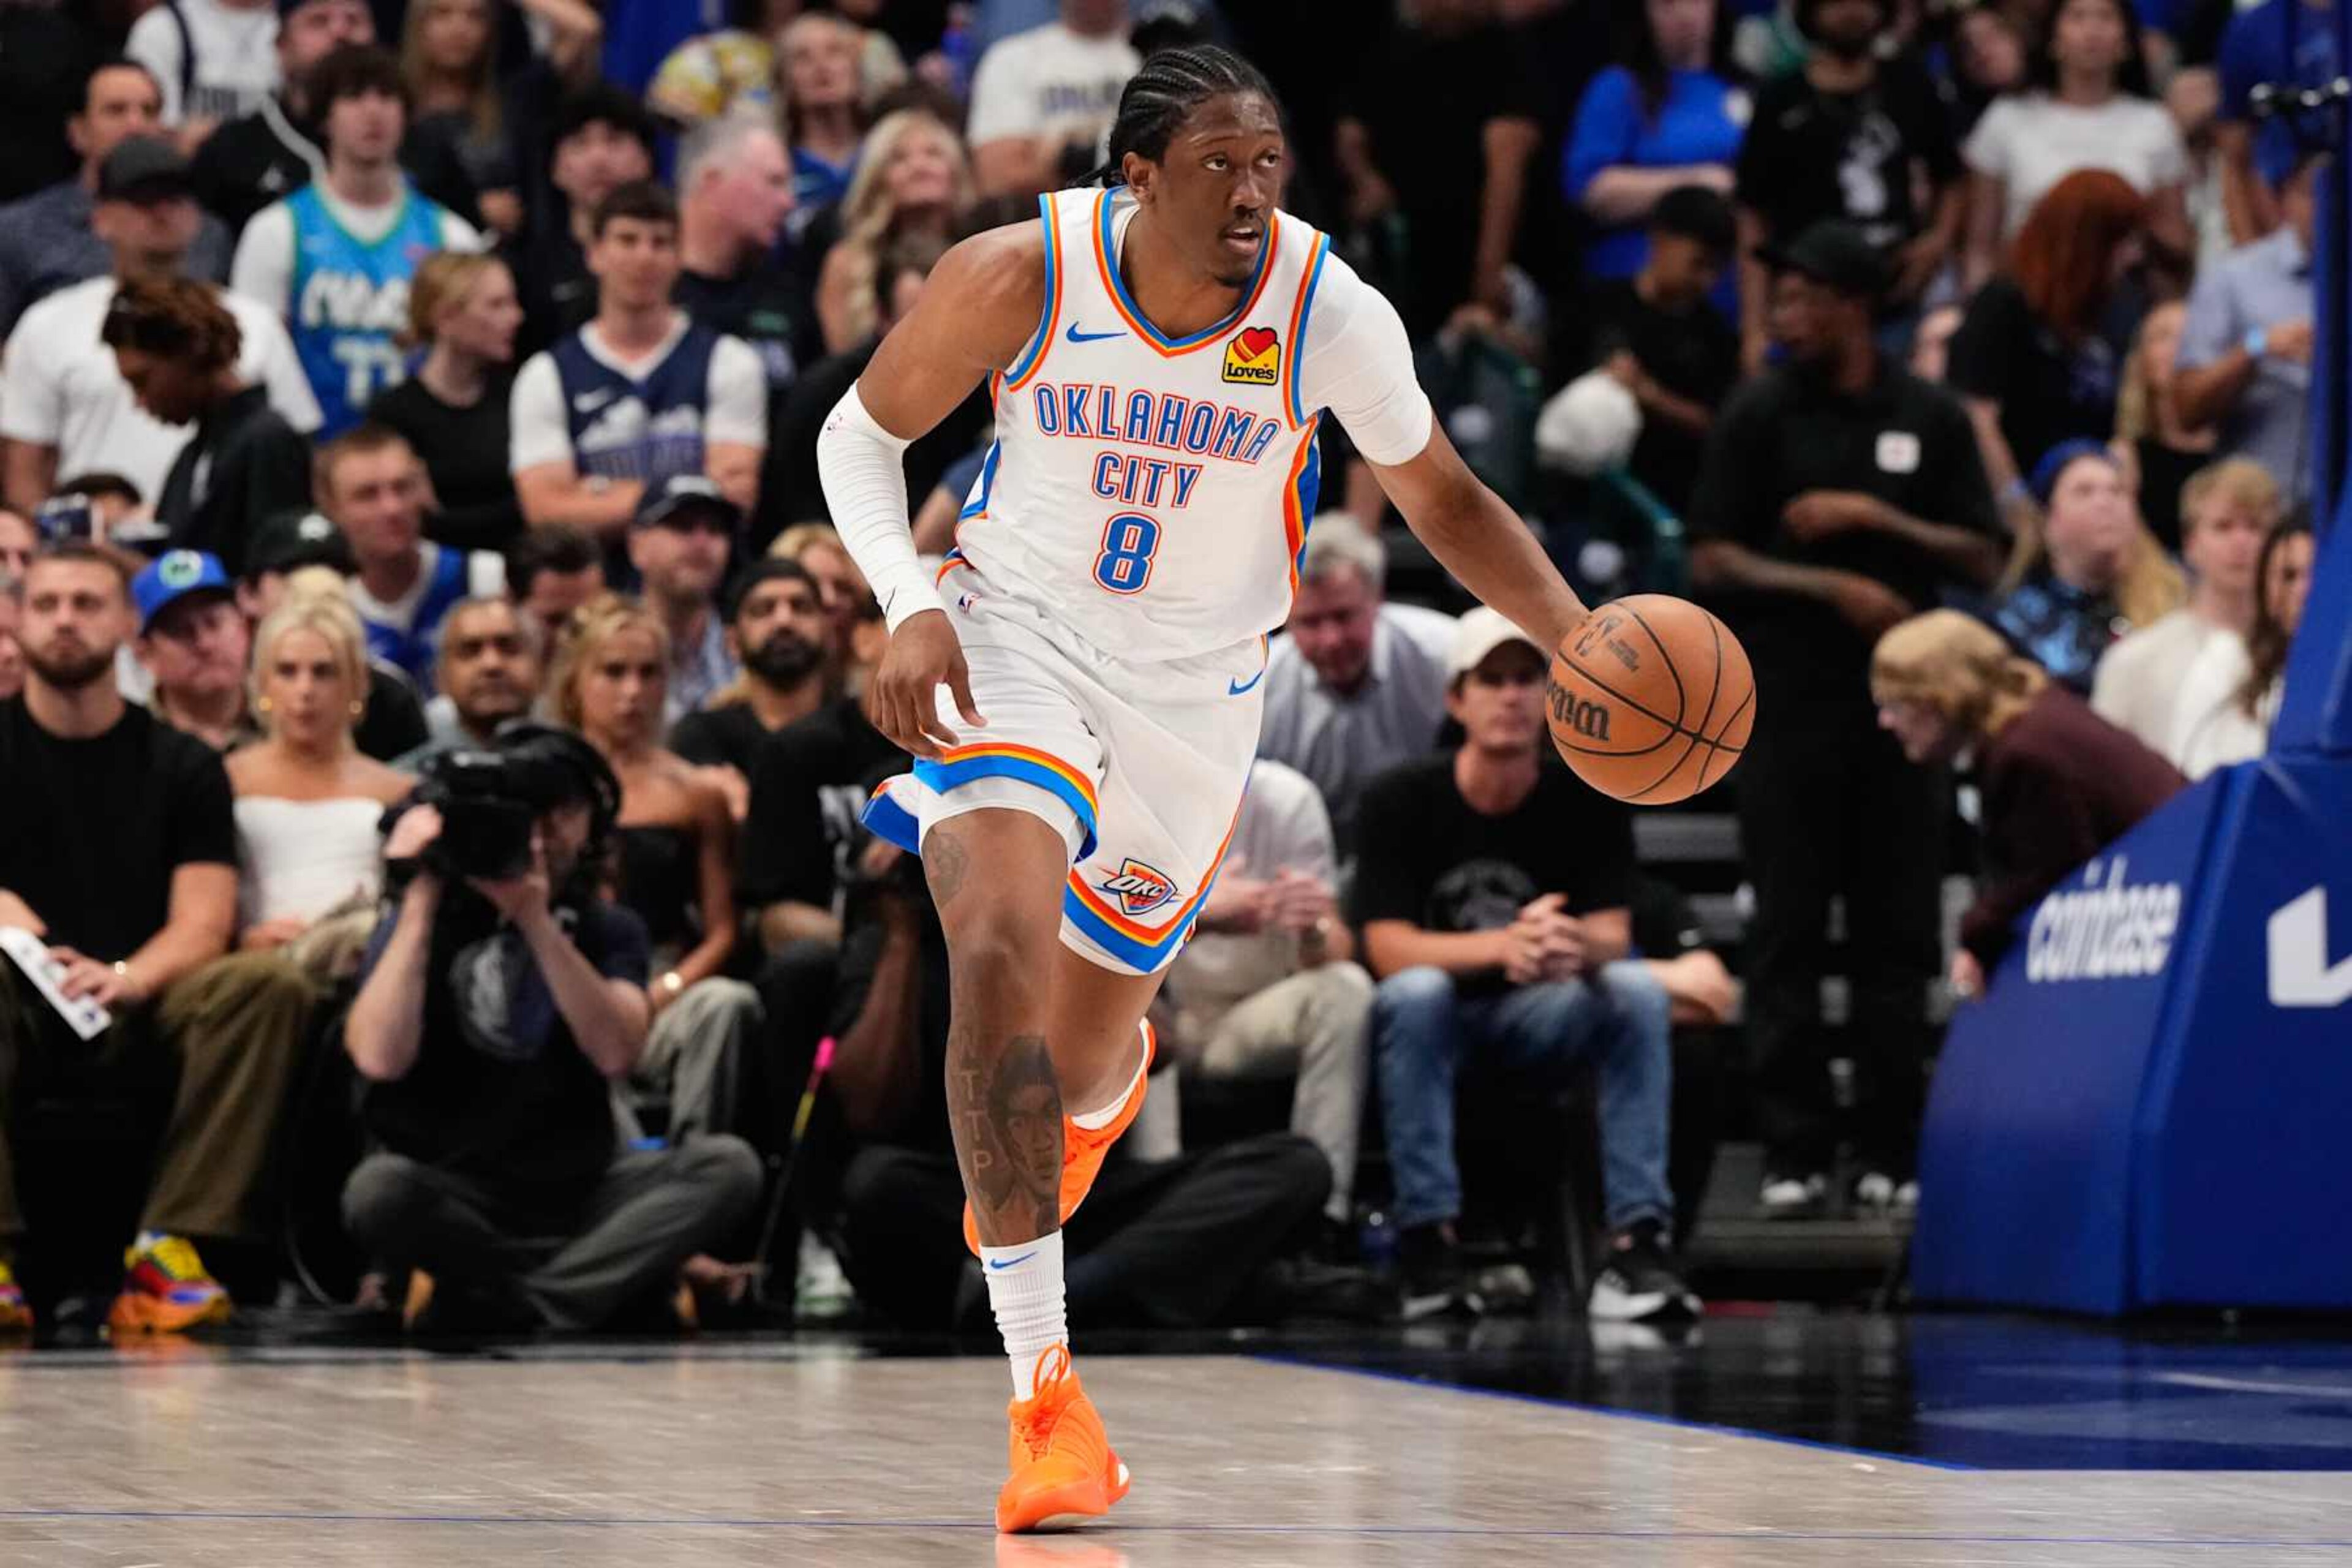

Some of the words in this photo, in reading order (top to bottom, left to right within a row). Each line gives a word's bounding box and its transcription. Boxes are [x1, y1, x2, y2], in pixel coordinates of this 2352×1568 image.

[1033, 383, 1281, 464] OKLAHOMA
[1092, 451, 1203, 508] CITY
[1093, 512, 1161, 594] 8
[2026, 854, 2181, 983] coinbase
